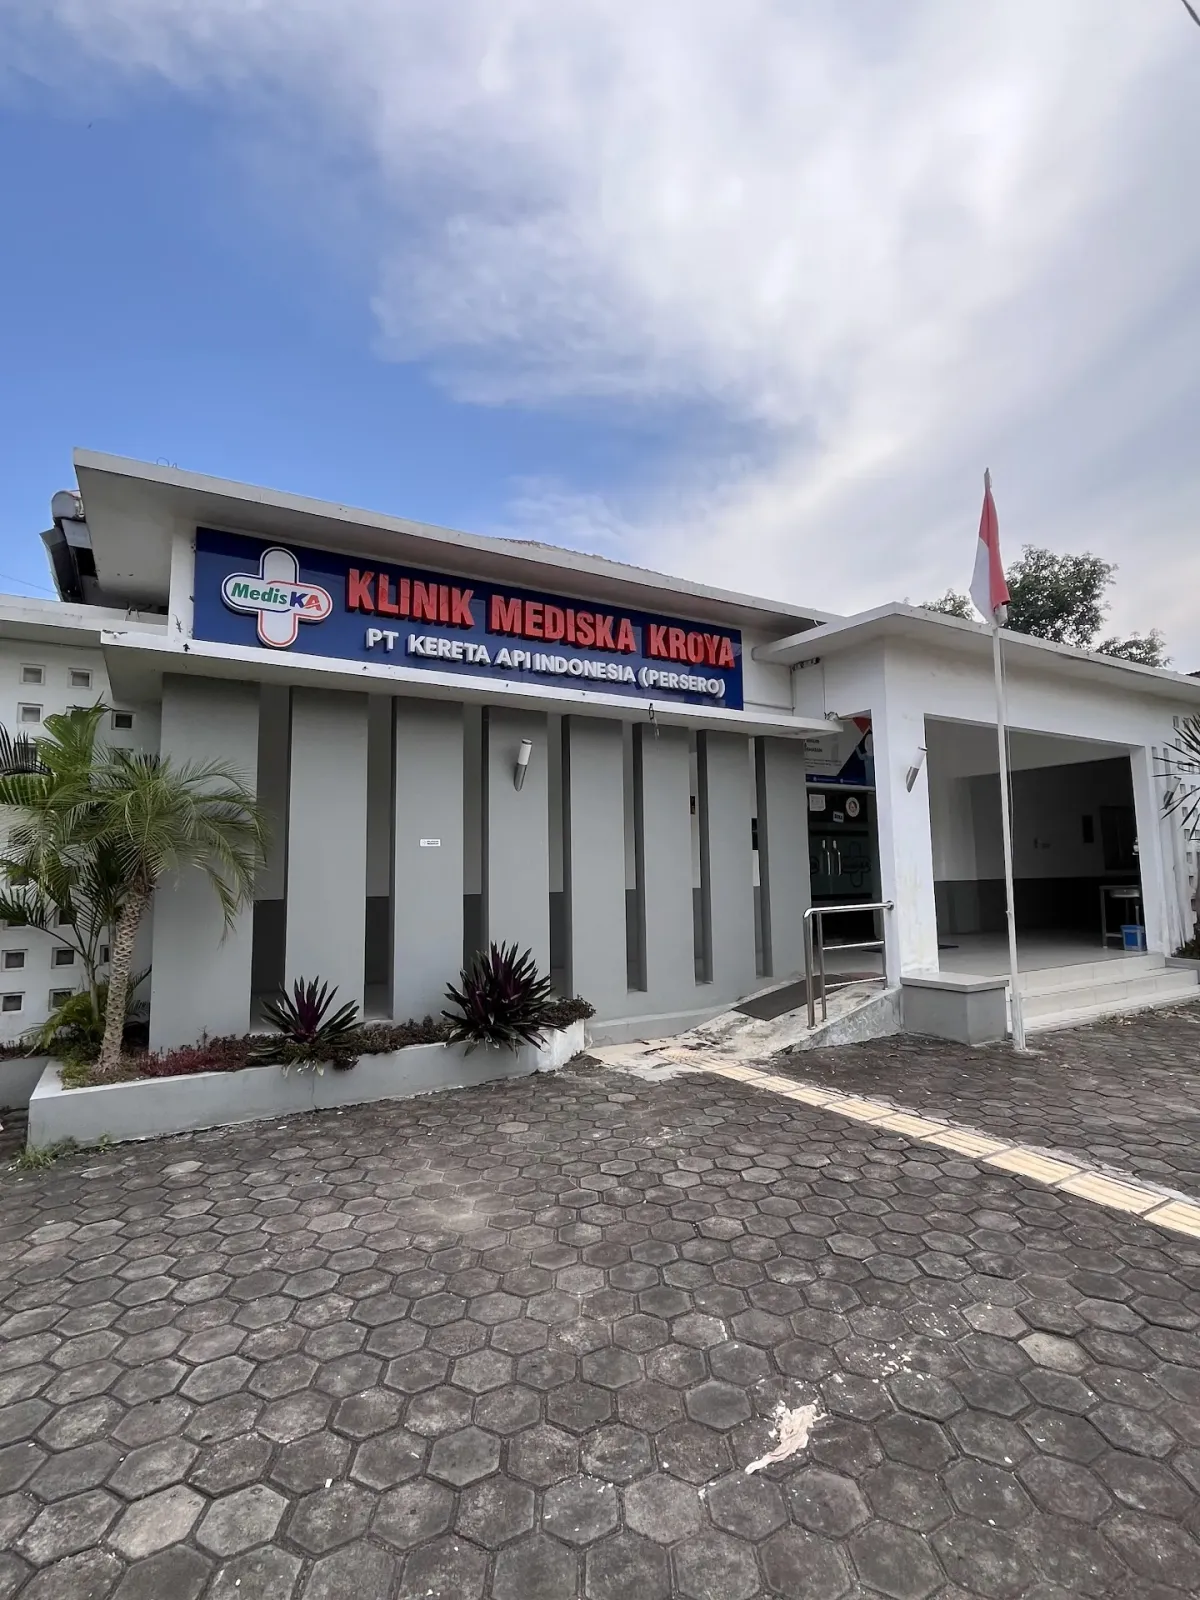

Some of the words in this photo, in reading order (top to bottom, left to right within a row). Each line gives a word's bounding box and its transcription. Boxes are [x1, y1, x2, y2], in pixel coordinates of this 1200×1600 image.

[231, 582, 322, 612] MedisKA
[346, 568, 475, 628] KLINIK
[489, 594, 637, 654] MEDISKA
[646, 623, 735, 668] KROYA
[366, 627, 399, 650] PT
[407, 633, 491, 664] KERETA
[494, 647, 531, 670] API
[532, 652, 636, 683] INDONESIA
[638, 666, 726, 698] (PERSERO)
